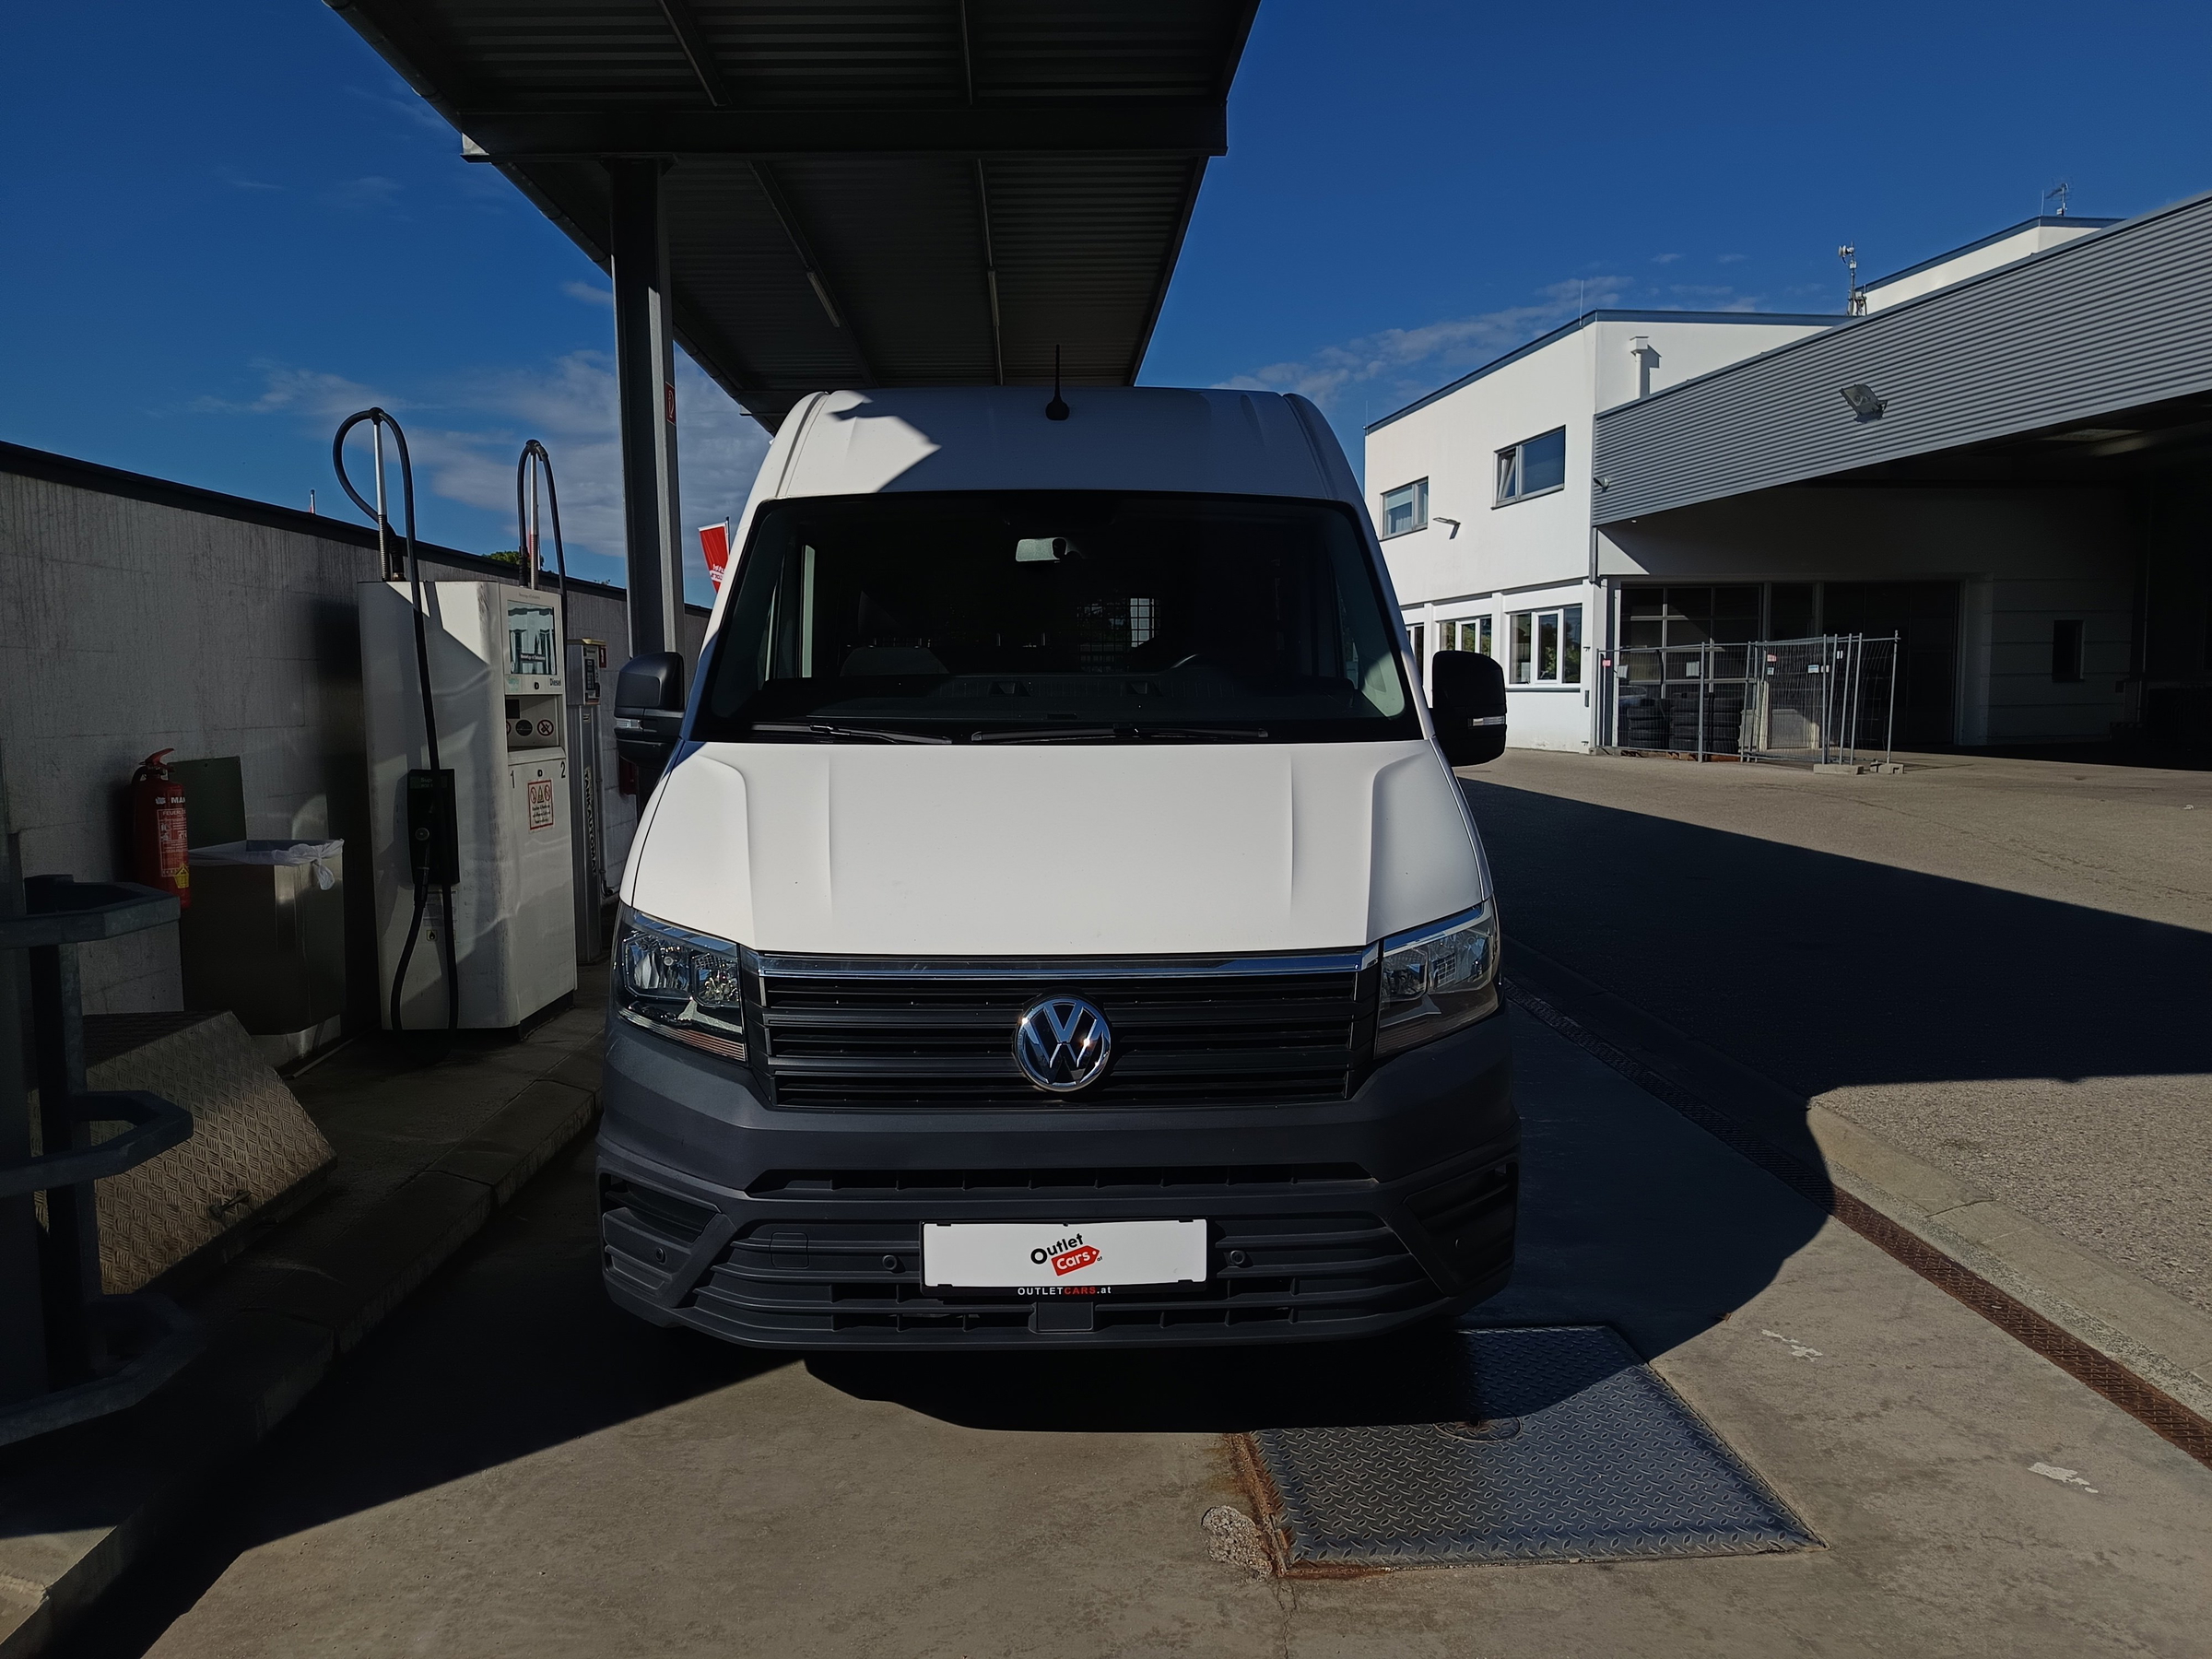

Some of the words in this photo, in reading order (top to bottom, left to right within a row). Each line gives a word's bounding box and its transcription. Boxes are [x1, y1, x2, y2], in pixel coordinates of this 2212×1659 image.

[550, 677, 561, 687] Diesel
[560, 760, 566, 779] 2
[511, 770, 515, 789] 1
[1030, 1233, 1083, 1265] Outlet
[1056, 1251, 1090, 1270] Cars
[1017, 1286, 1112, 1296] OUTLETCARS.at
